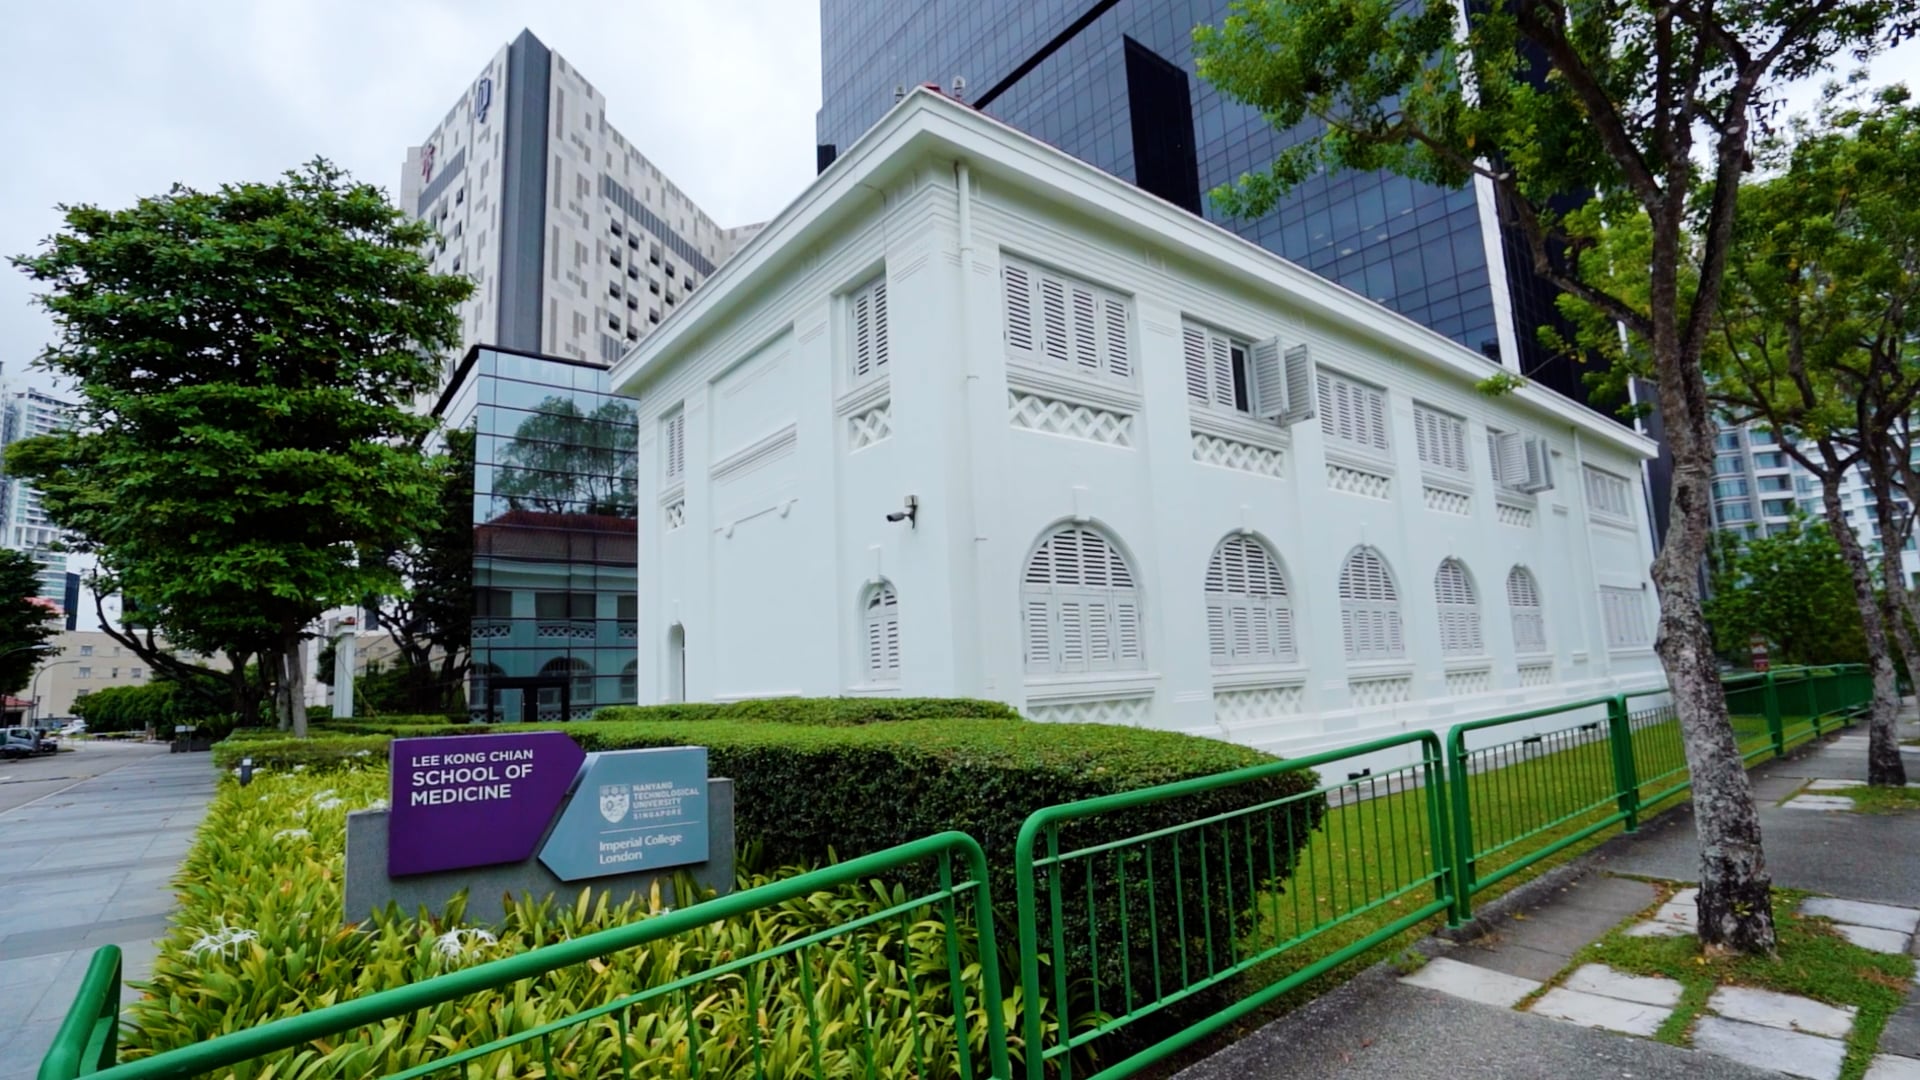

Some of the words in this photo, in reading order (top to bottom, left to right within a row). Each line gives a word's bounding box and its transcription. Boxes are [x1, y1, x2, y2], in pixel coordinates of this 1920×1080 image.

[412, 755, 440, 767] LEE
[444, 753, 486, 765] KONG
[489, 749, 533, 762] CHIAN
[412, 766, 500, 786] SCHOOL
[505, 764, 533, 779] OF
[632, 781, 673, 792] NANYANG
[411, 784, 511, 806] MEDICINE
[633, 788, 699, 800] TECHNOLOGICAL
[632, 798, 681, 809] UNIVERSITY
[633, 808, 682, 819] SINGAPORE
[600, 836, 642, 853] Imperial
[644, 834, 683, 846] College
[600, 851, 642, 864] London
